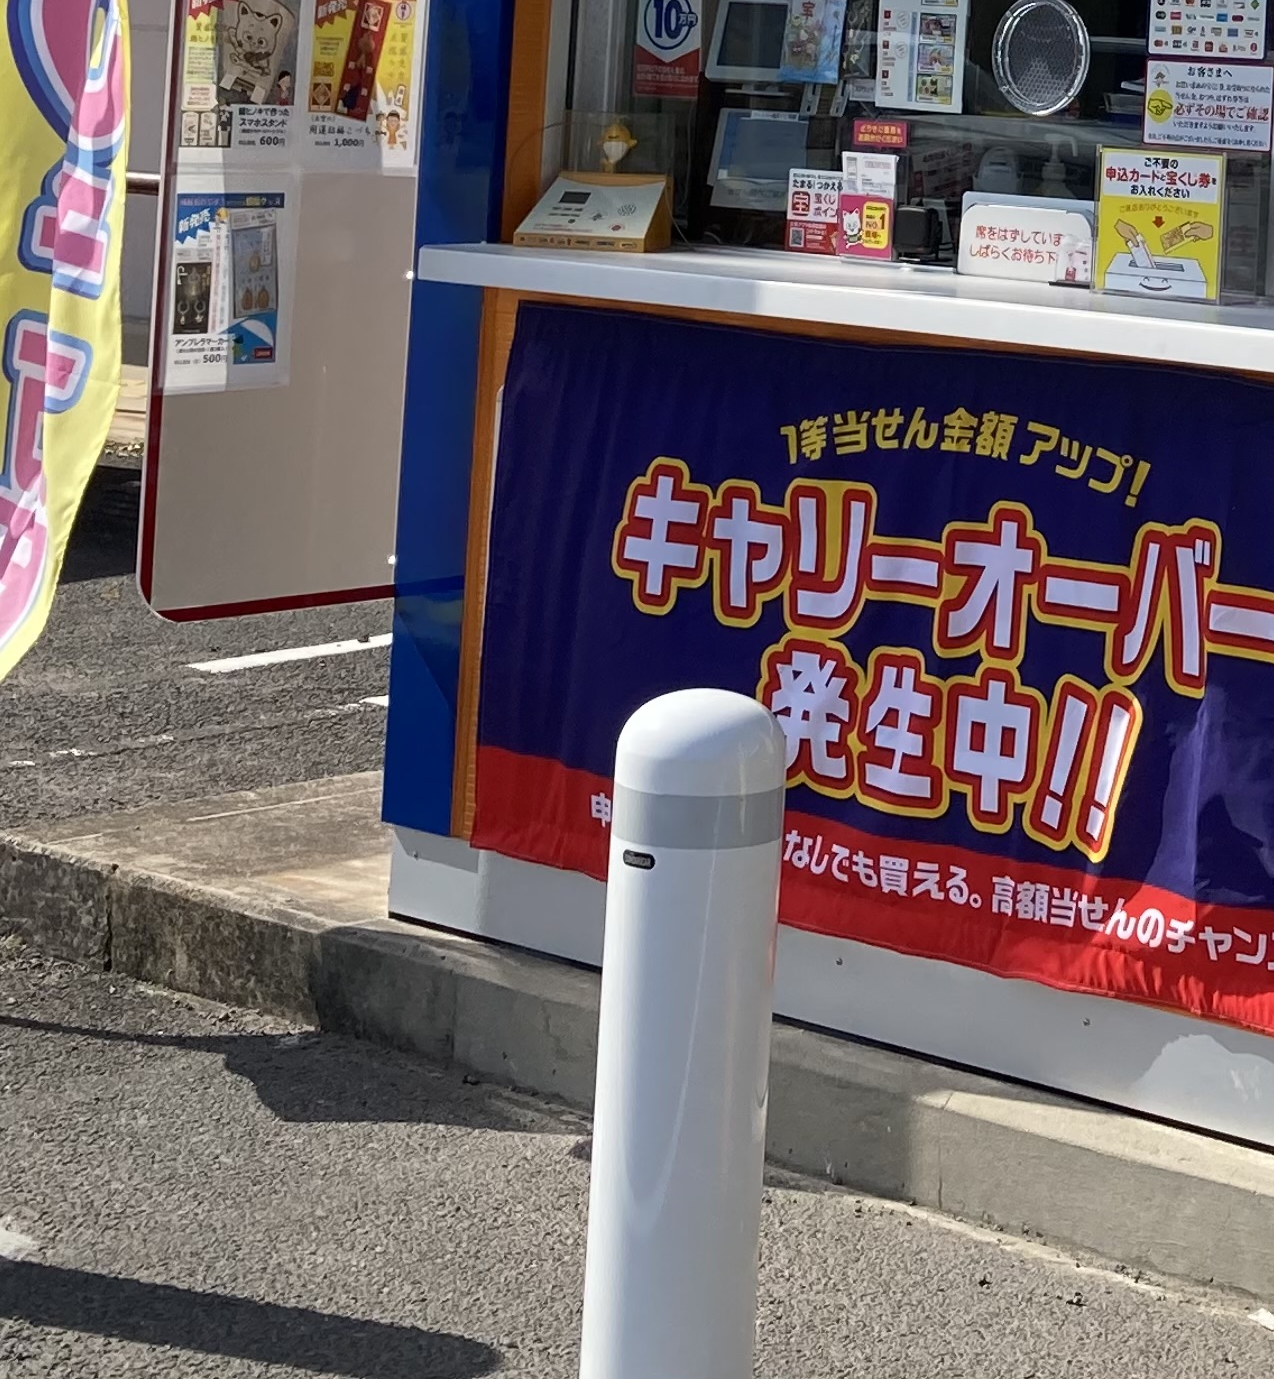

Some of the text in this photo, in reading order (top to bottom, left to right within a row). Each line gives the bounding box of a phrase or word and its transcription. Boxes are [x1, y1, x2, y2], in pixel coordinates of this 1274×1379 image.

[970, 244, 1056, 264] しばらくお待ち下
[976, 226, 1063, 246] 席をはずしていま
[781, 407, 1151, 507] 1等当せん金額 アップ!
[768, 641, 1136, 853] 発生中!!
